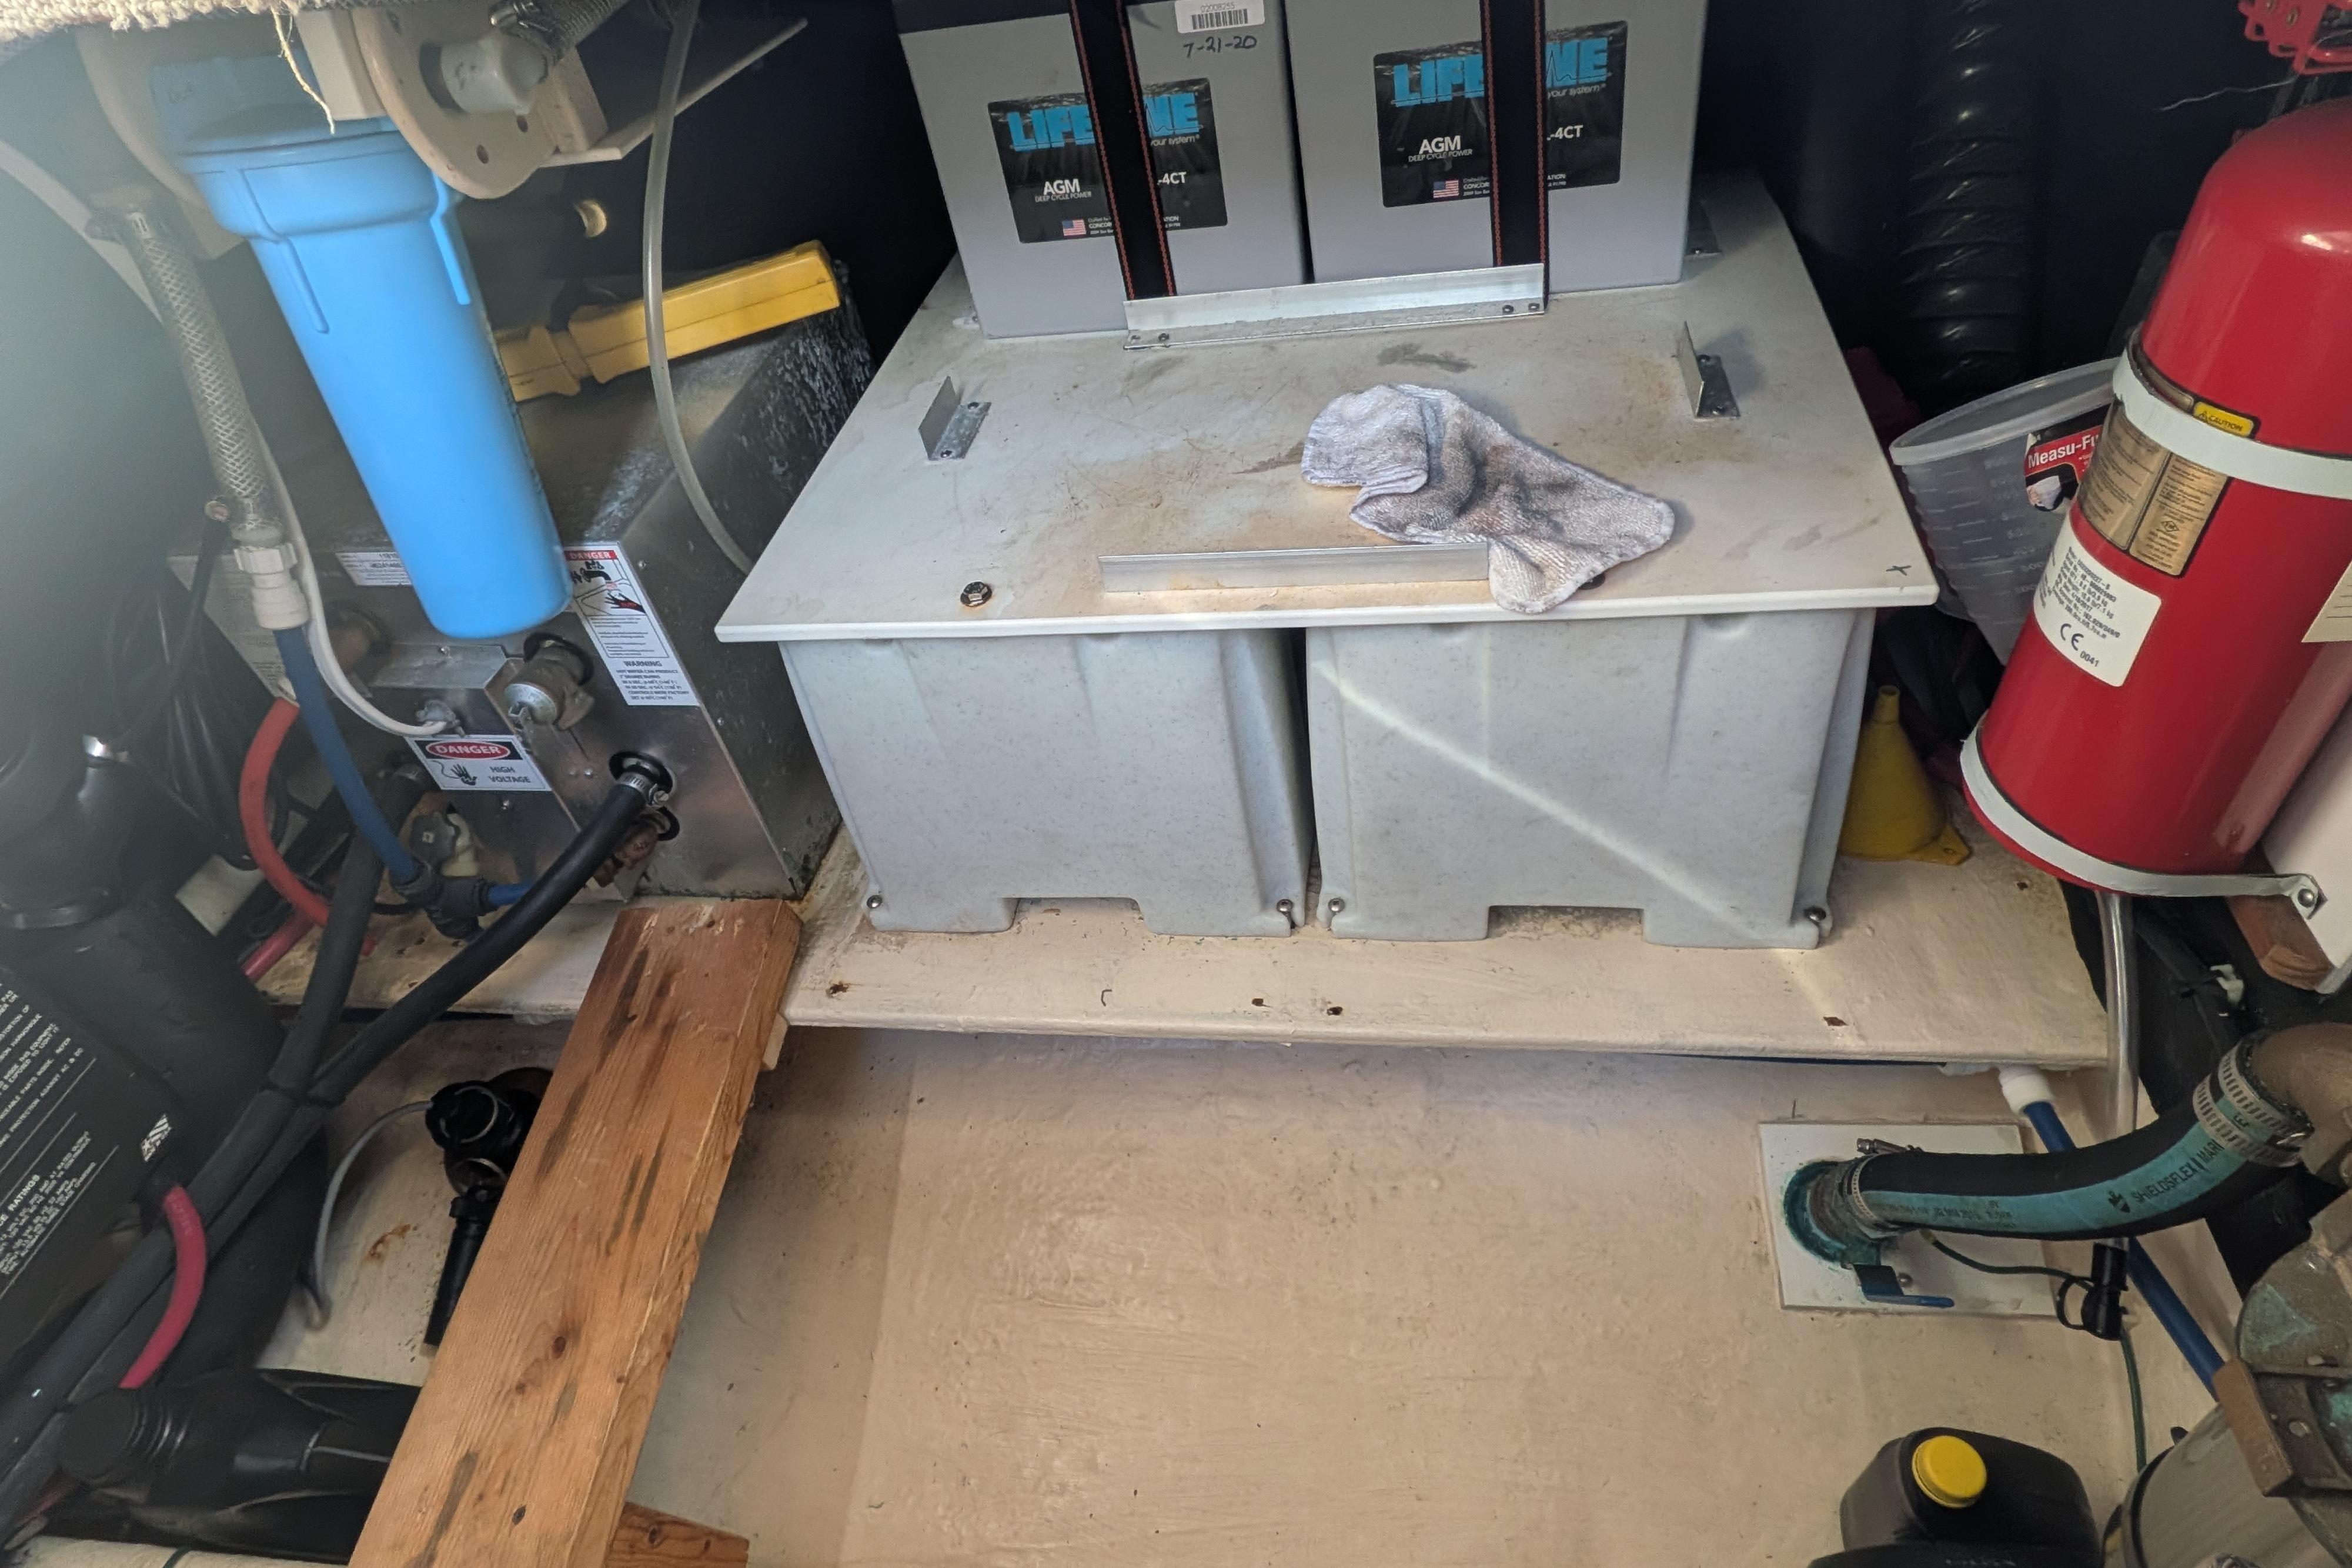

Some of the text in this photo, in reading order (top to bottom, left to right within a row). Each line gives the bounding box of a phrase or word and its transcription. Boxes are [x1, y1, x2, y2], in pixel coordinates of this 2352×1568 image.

[1183, 35, 1257, 58] 7-21-20
[1419, 135, 1461, 155] AGM
[1043, 178, 1080, 195] AGM
[570, 551, 612, 560] DANGER
[2079, 650, 2100, 667] 0041
[435, 744, 501, 754] DANGER
[8, 1175, 40, 1211] RATINGS
